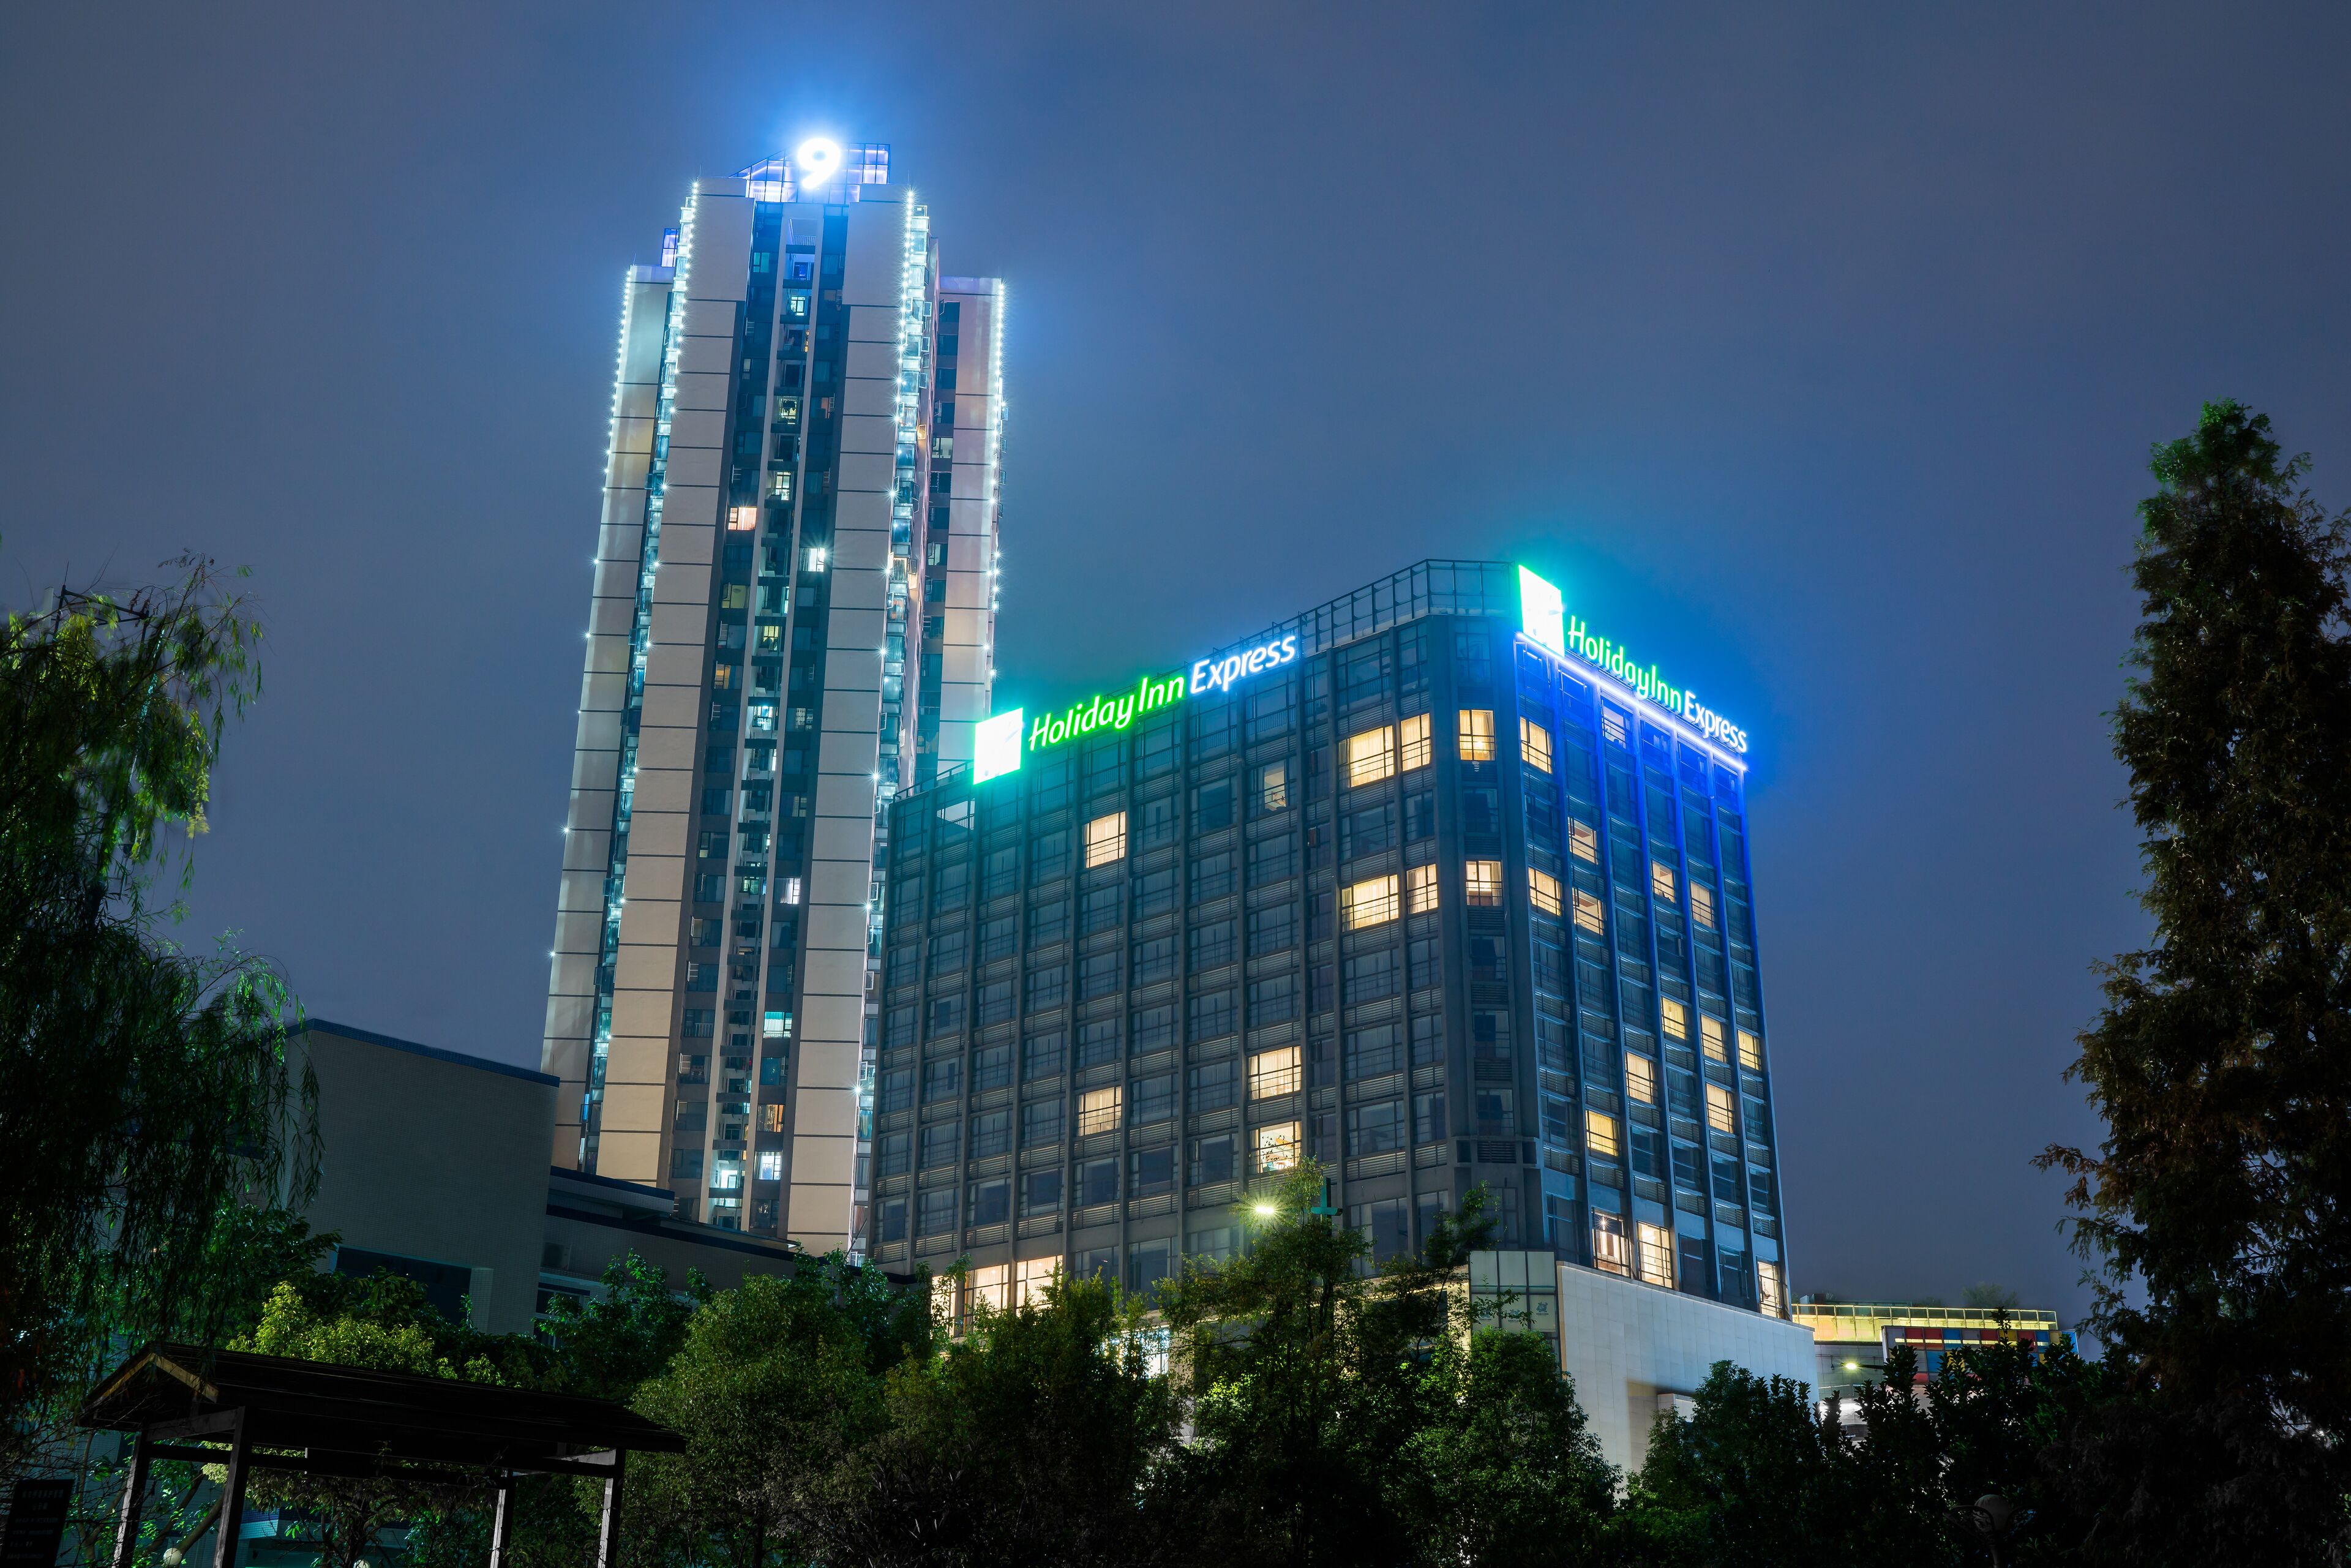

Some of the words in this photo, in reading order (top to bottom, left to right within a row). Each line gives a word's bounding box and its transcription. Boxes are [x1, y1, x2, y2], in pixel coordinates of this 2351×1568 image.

[798, 138, 841, 190] 9
[1190, 636, 1296, 694] Express
[1684, 690, 1747, 753] Express
